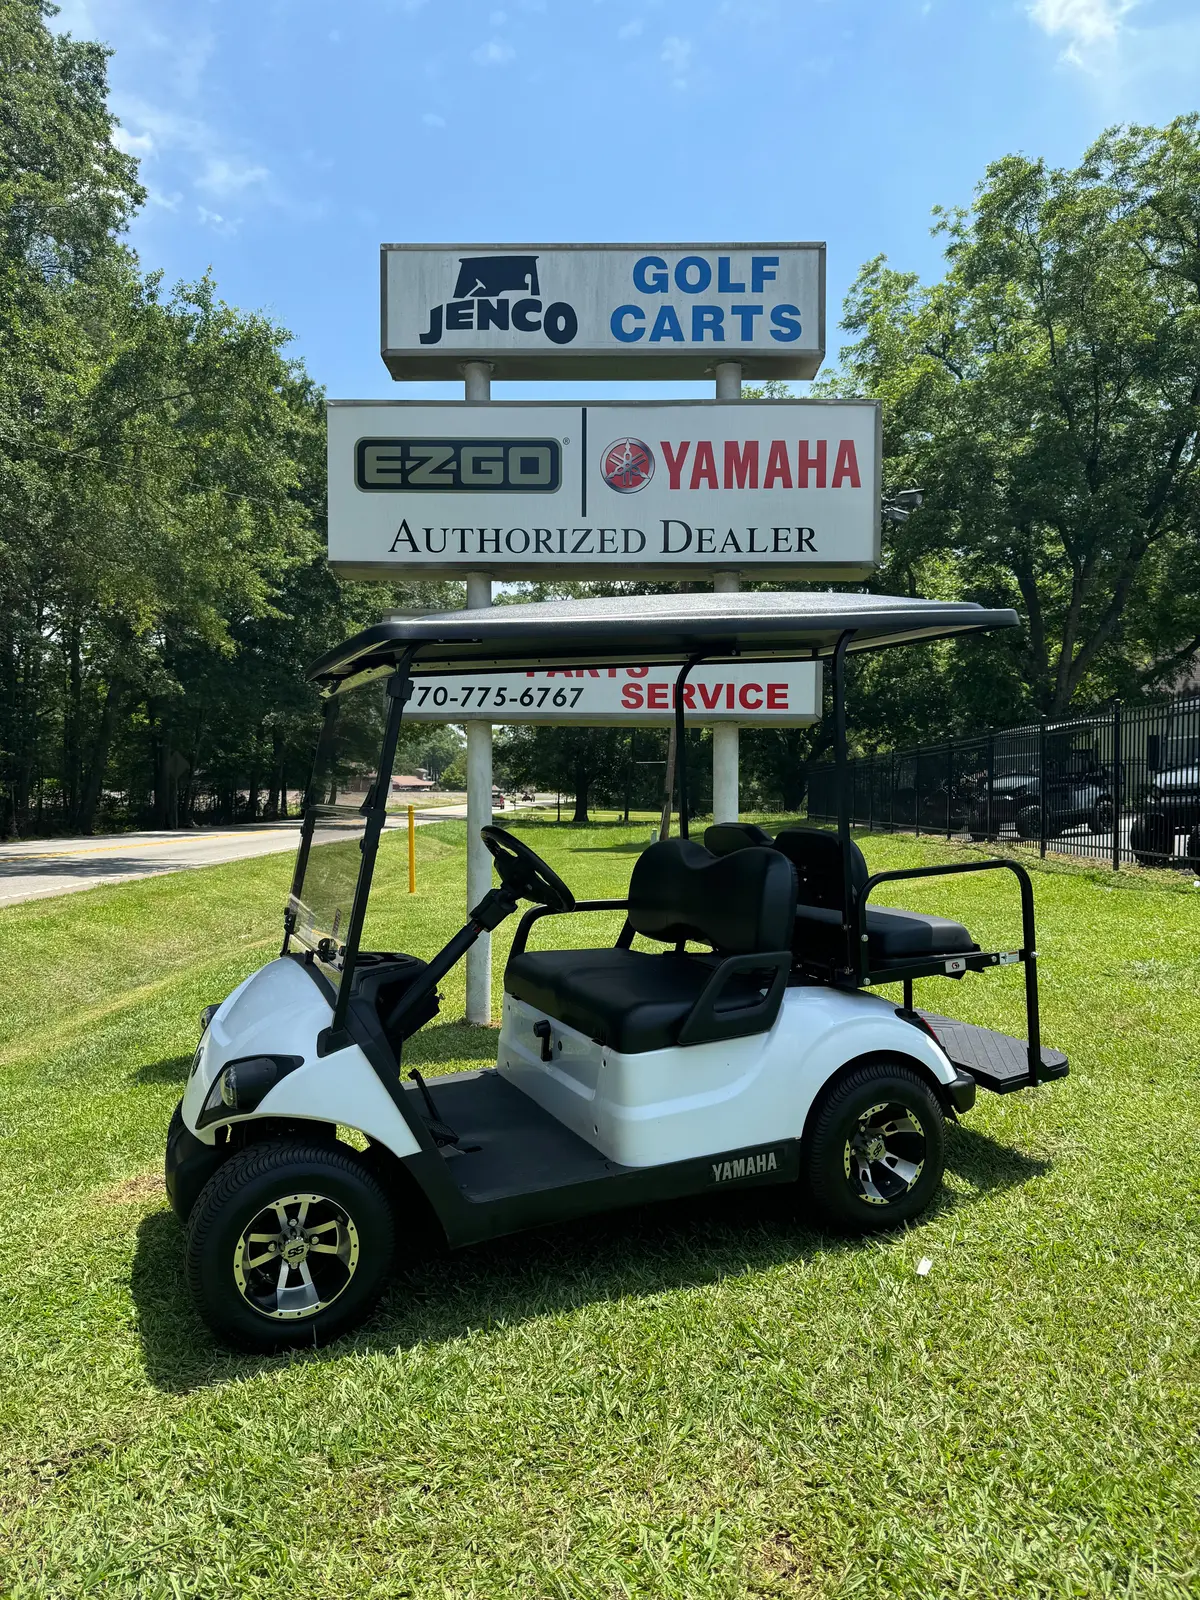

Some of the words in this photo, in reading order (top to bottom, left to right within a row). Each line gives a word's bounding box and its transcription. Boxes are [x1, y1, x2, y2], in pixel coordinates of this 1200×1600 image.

[633, 256, 780, 294] GOLF
[419, 299, 578, 345] JENCO
[610, 304, 803, 343] CARTS
[660, 439, 862, 490] YAMAHA
[411, 686, 585, 708] 70-775-6767
[621, 683, 789, 709] SERVICE
[712, 1152, 777, 1182] YAMAHA
[287, 1245, 305, 1258] SS
